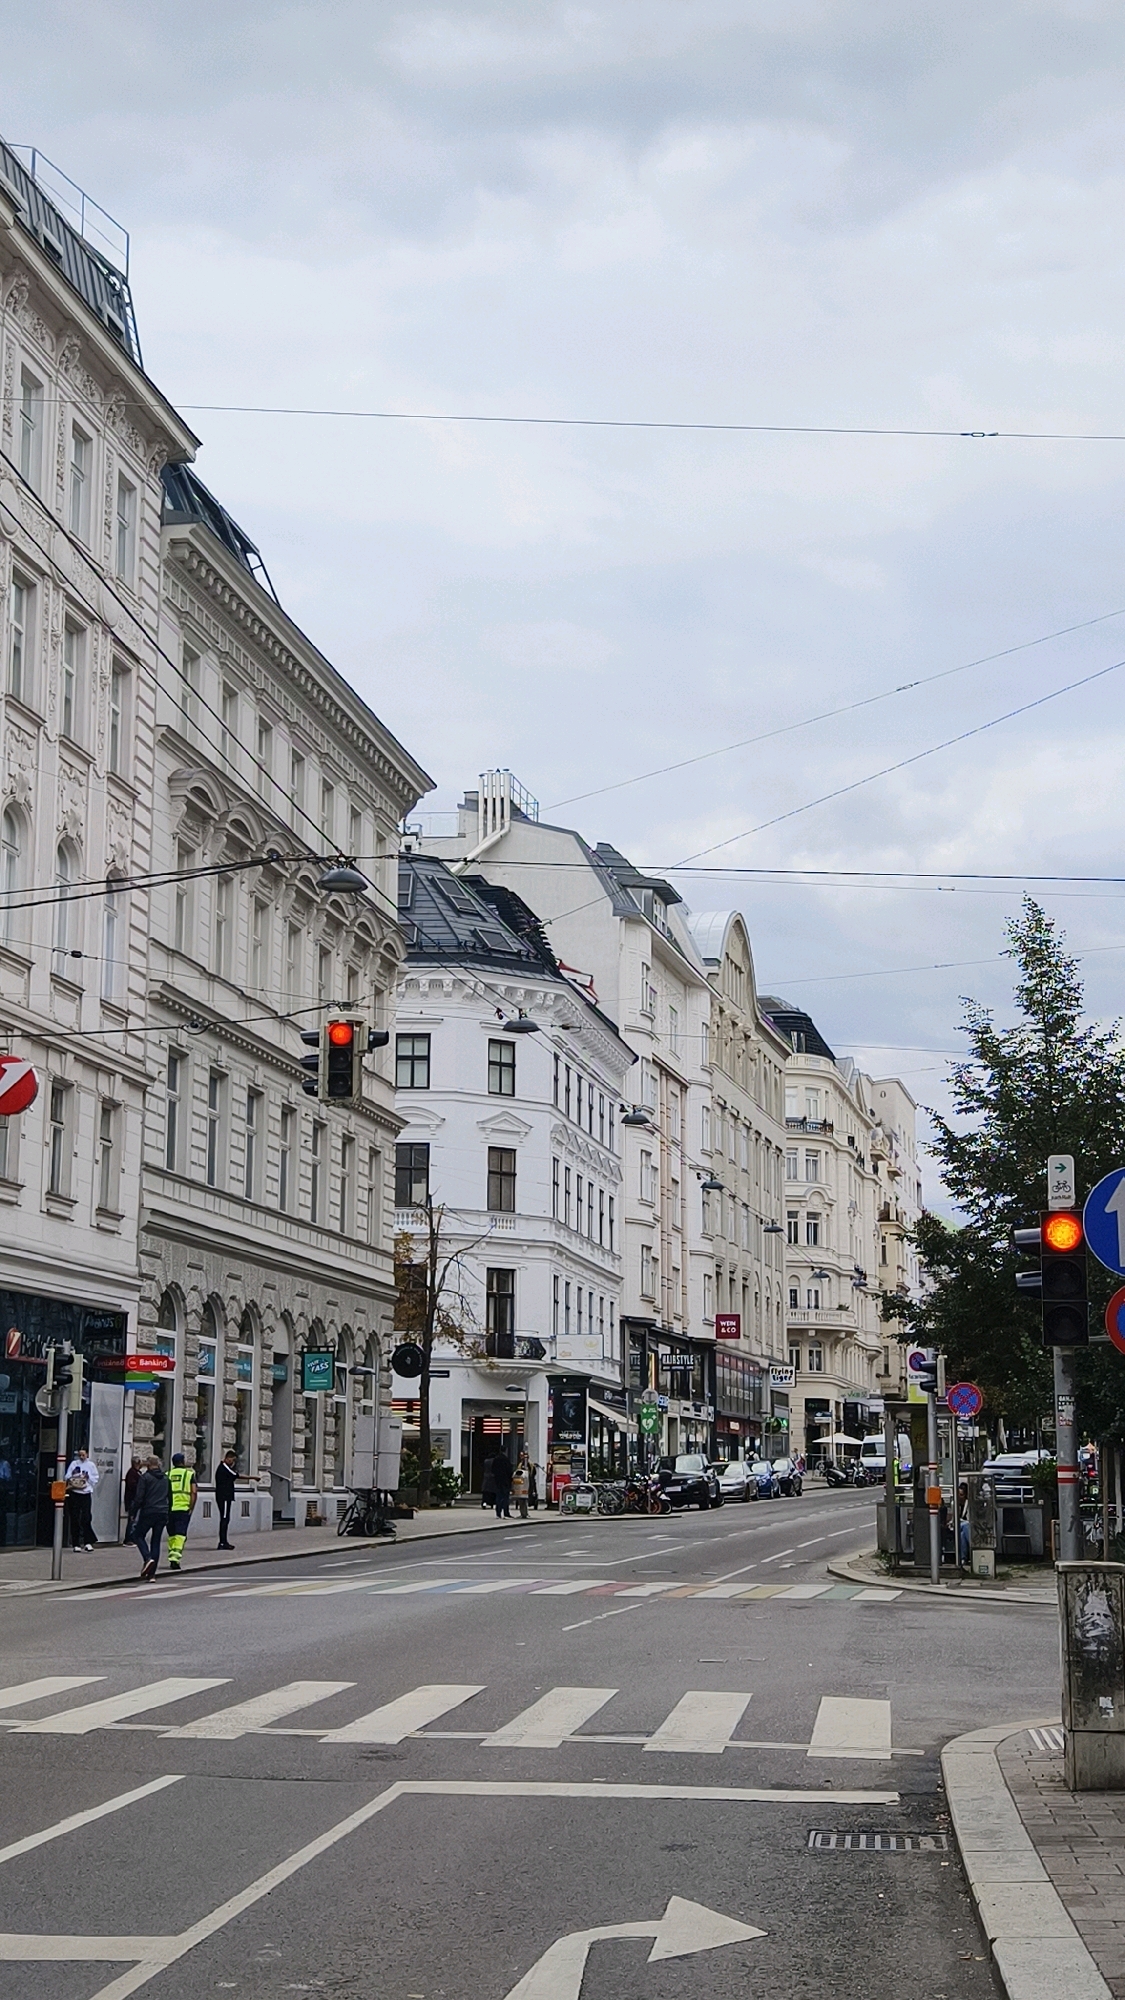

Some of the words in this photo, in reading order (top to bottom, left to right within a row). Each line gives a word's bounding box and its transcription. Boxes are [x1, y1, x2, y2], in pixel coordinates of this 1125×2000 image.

[139, 1358, 167, 1368] Banking
[771, 1367, 793, 1376] flying
[772, 1374, 793, 1382] tiger
[566, 1494, 575, 1505] P
